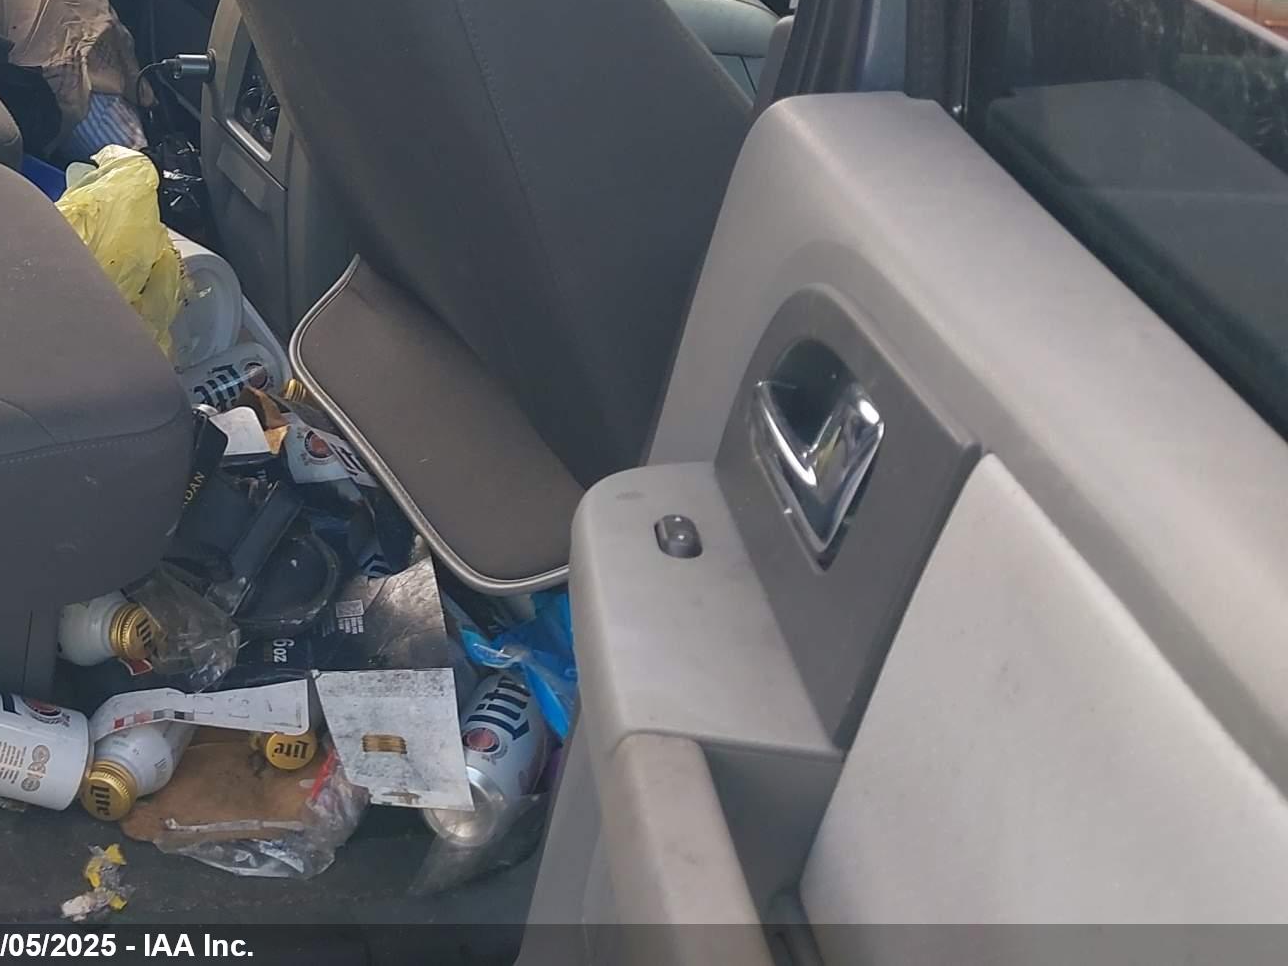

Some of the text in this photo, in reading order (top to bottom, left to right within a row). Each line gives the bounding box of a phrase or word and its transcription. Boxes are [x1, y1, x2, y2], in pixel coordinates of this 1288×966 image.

[465, 676, 531, 741] Lite
[273, 740, 309, 759] Lite
[90, 784, 111, 816] Lite
